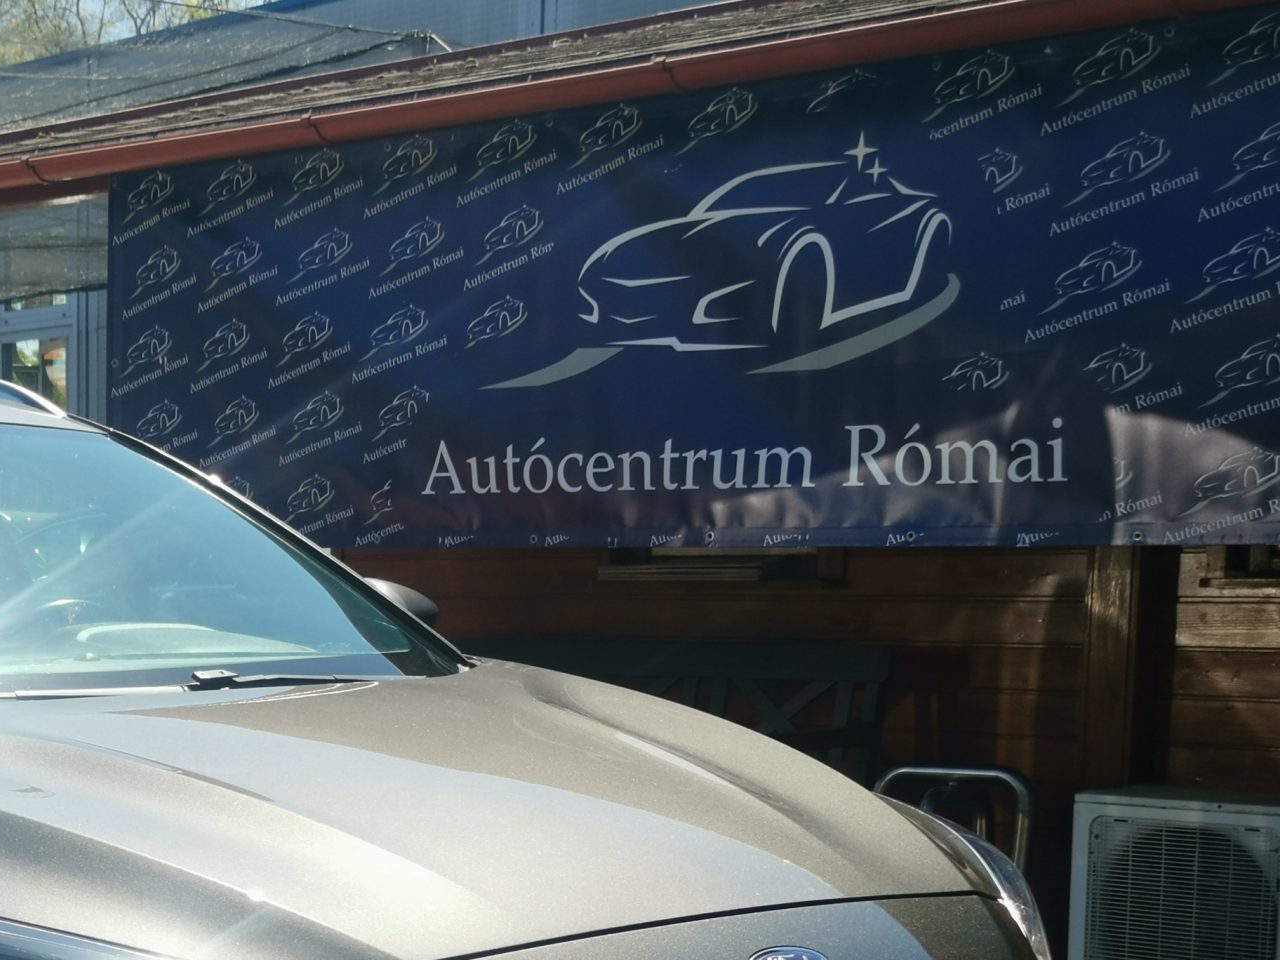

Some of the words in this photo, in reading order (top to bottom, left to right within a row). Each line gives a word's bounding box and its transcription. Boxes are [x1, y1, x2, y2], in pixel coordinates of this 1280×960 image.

[929, 106, 994, 141] ócentrum
[996, 83, 1043, 113] Római
[1040, 87, 1138, 136] Autócentrum
[1141, 63, 1192, 95] Római
[1049, 190, 1146, 237] Autócentrum
[1150, 167, 1200, 198] Római
[1197, 180, 1280, 223] Autócentr
[1024, 299, 1118, 344] Autócentrum
[1122, 278, 1172, 308] Római
[1169, 286, 1272, 334] Autócentrum
[1135, 381, 1183, 410] Római
[363, 438, 408, 464] Autócentr
[421, 438, 816, 496] Autócentrum
[842, 417, 1068, 488] Római
[1115, 490, 1163, 517] Római
[1162, 505, 1265, 545] Autócentrum
